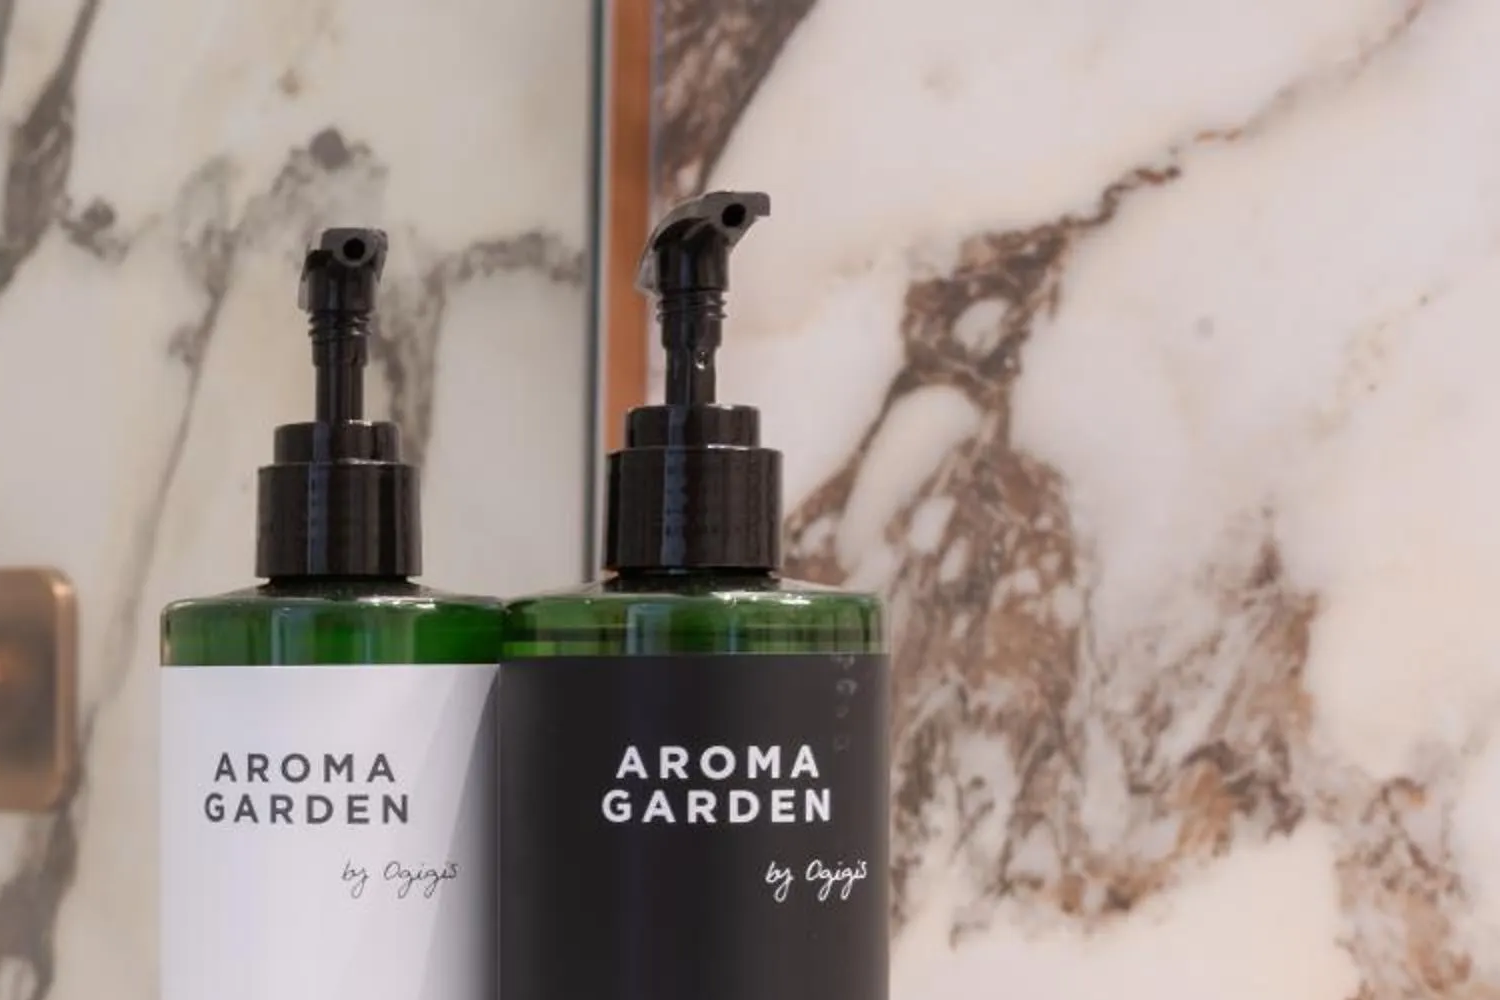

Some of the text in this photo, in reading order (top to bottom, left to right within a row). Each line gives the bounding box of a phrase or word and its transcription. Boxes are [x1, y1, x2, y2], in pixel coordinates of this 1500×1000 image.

[213, 752, 396, 784] AROMA
[615, 745, 820, 781] AROMA
[203, 793, 409, 825] GARDEN
[601, 788, 832, 824] GARDEN
[341, 858, 370, 900] by
[764, 860, 795, 903] by
